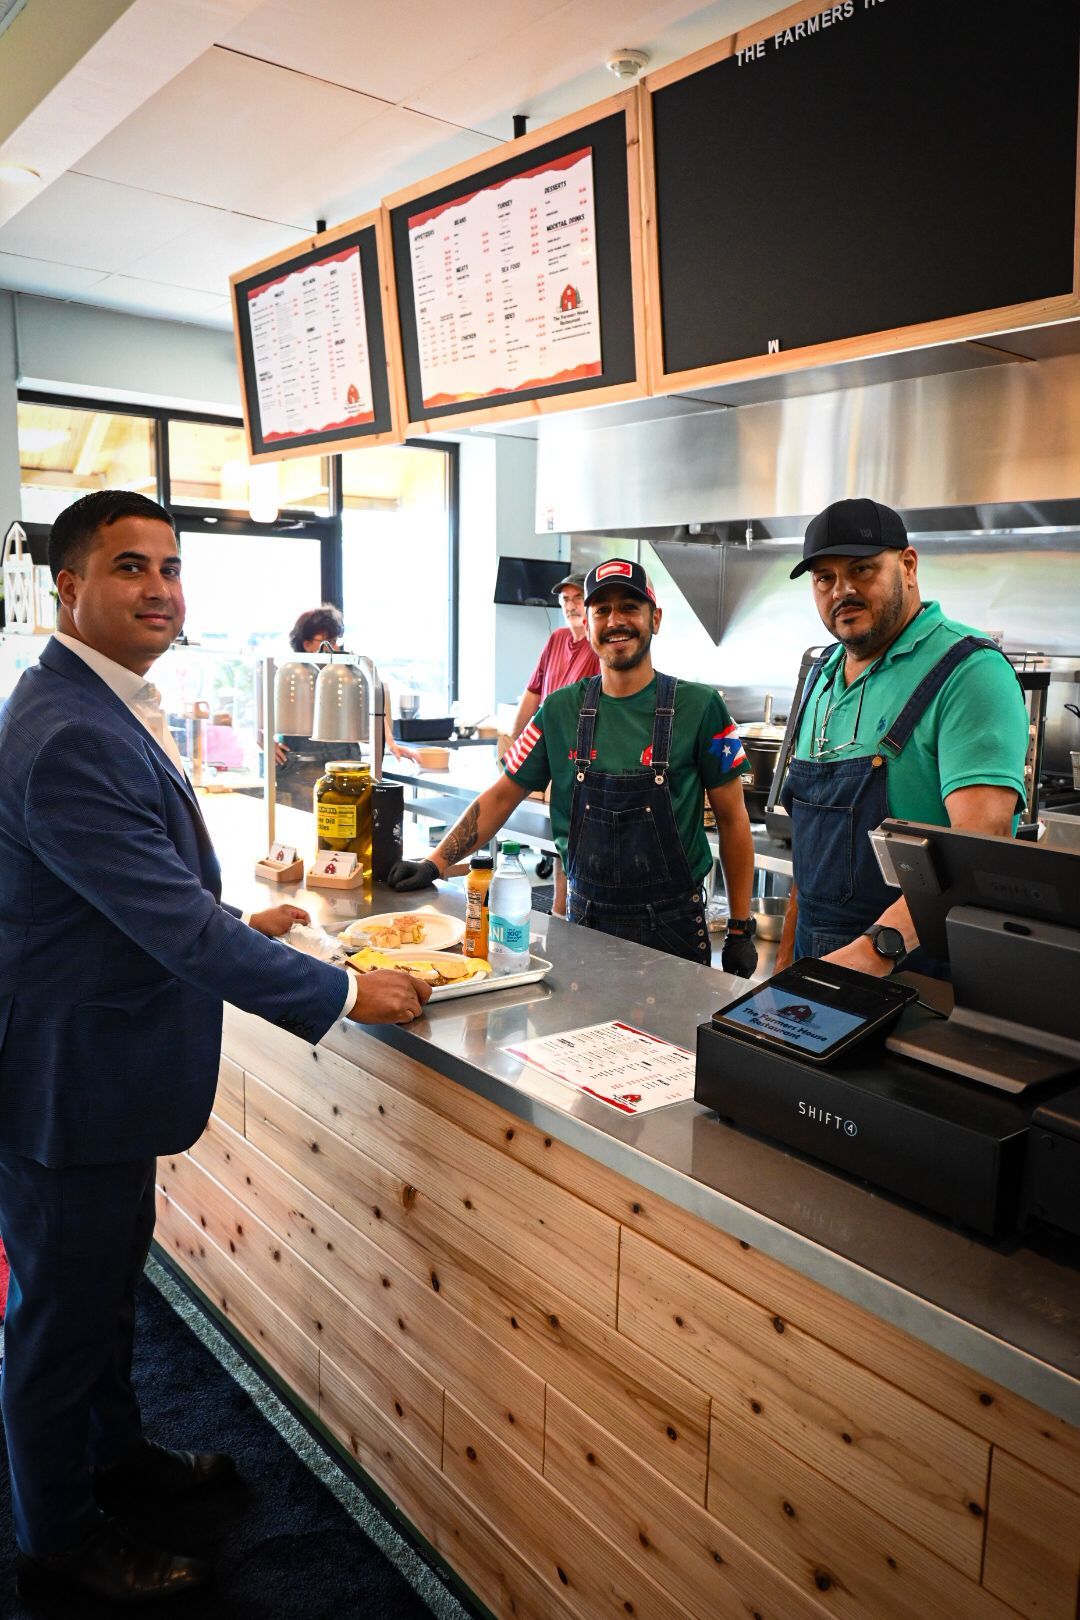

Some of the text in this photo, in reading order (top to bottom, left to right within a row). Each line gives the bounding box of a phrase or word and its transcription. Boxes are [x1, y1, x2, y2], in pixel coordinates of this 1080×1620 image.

[735, 1, 855, 67] THE FARMERS
[544, 180, 567, 195] DESSERTS
[743, 1007, 828, 1042] The Farmers House
[749, 1017, 801, 1040] Restaurant
